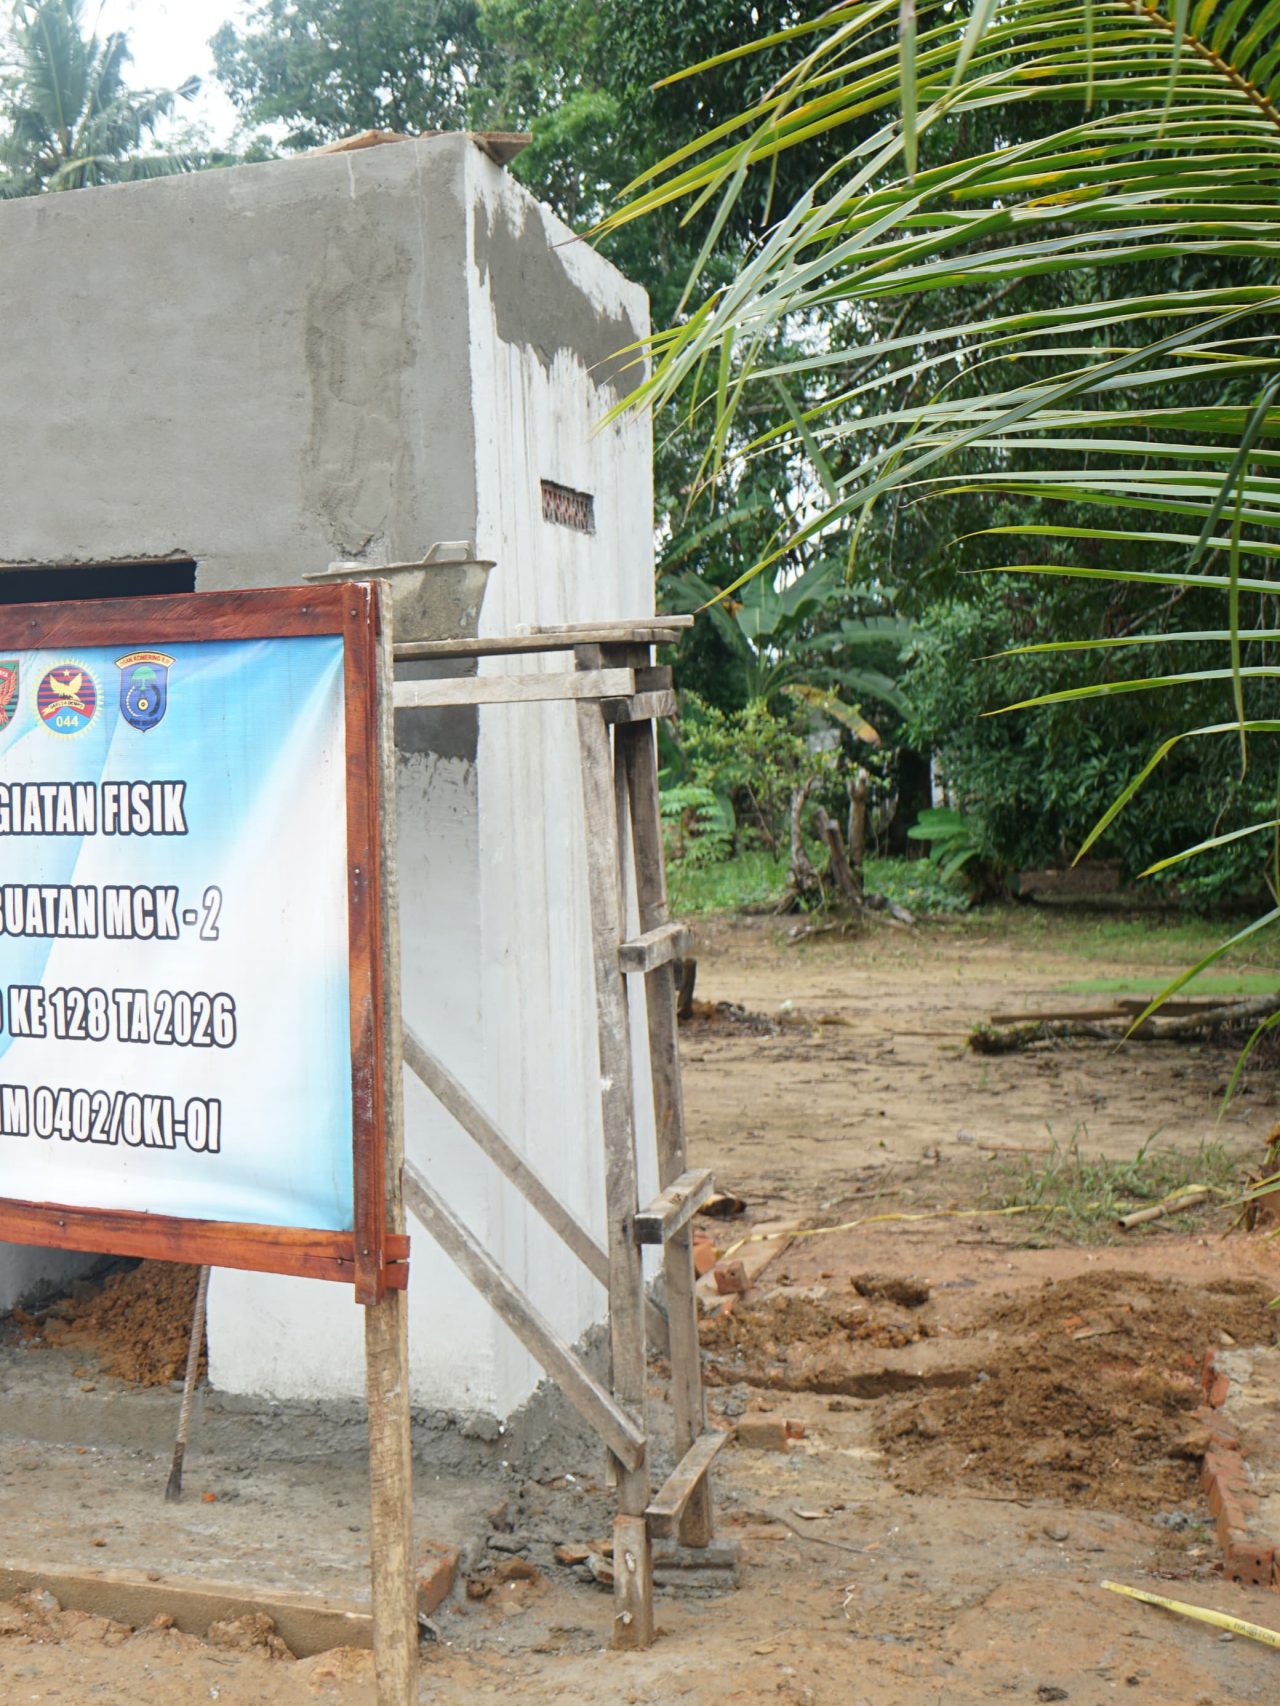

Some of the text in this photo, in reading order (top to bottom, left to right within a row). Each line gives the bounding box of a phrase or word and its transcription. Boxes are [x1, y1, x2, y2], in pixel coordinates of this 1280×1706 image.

[55, 715, 79, 728] 044
[101, 780, 189, 836] FISIK
[103, 885, 179, 940] MCK
[7, 985, 47, 1038] KE
[49, 986, 109, 1041] 128
[113, 988, 151, 1044] TA
[153, 990, 237, 1049] 2026
